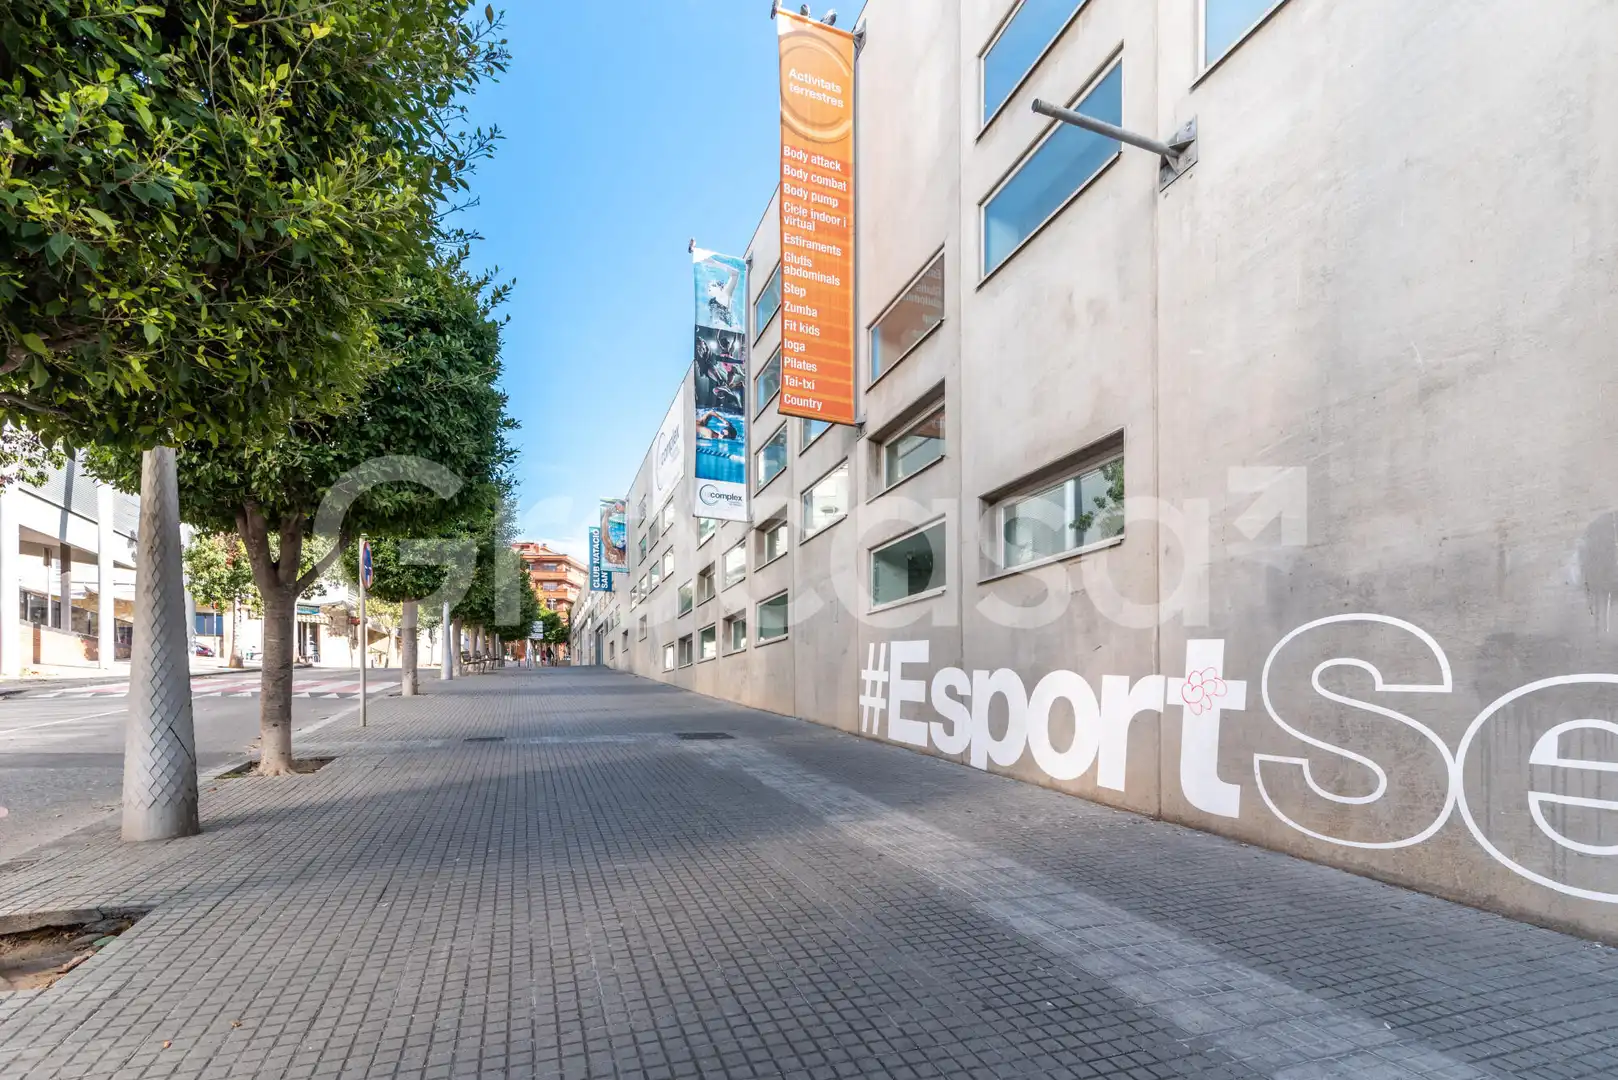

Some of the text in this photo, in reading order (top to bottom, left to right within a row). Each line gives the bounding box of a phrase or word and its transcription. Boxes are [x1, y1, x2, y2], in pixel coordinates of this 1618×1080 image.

[789, 68, 842, 93] Activitats
[790, 82, 844, 108] terrestres
[784, 146, 841, 171] Body attack
[784, 164, 847, 191] Body combat
[784, 183, 838, 208] Body pump
[784, 202, 808, 216] Cicle
[811, 209, 841, 225] indoor
[784, 216, 815, 231] virtual
[784, 232, 841, 256] Estiraments
[784, 264, 840, 286] abdominals
[784, 282, 806, 297] Step
[784, 301, 818, 317] Zumba
[784, 320, 820, 336] Fit kids
[784, 357, 817, 372] Pilates
[784, 375, 815, 389] Tai-txi
[784, 393, 822, 411] Country
[592, 565, 600, 588] CLUB
